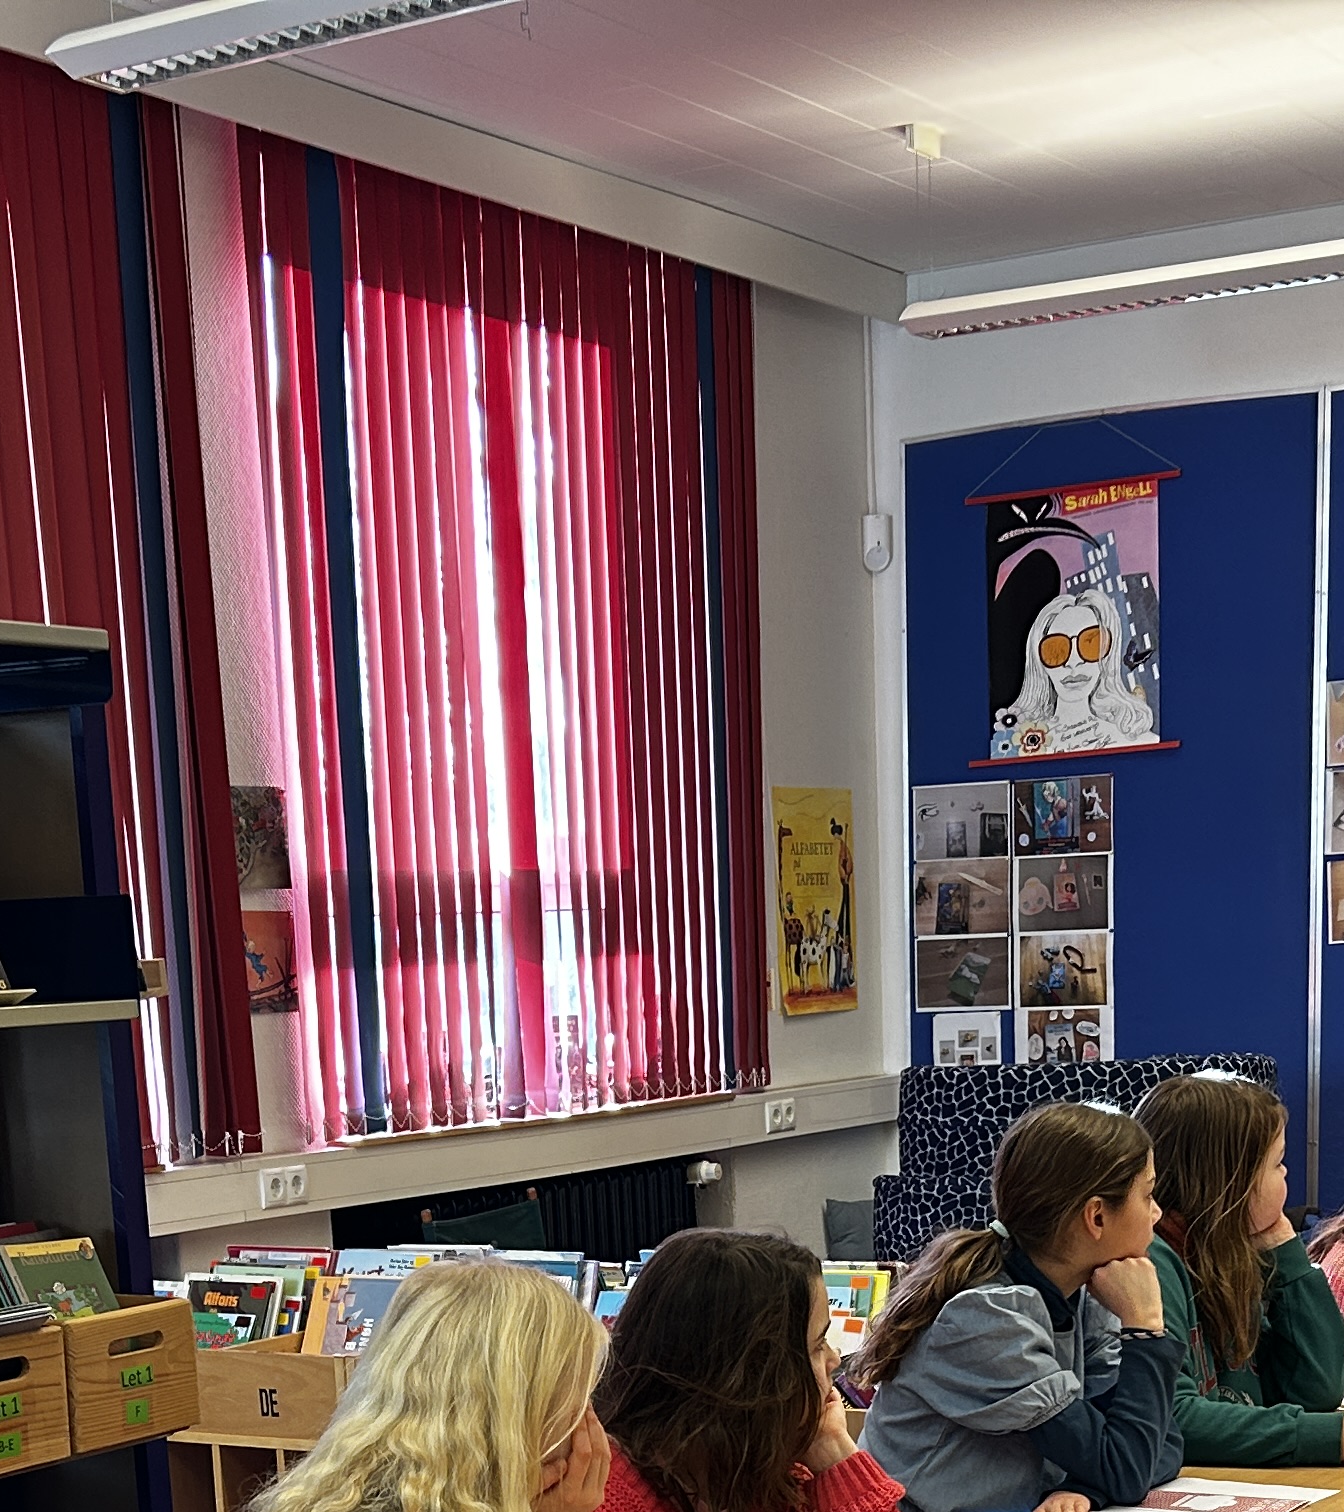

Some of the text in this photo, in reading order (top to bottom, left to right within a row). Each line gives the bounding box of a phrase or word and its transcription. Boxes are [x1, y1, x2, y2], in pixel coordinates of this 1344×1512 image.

[1064, 488, 1108, 511] Sarah
[203, 1291, 239, 1308] Alfons
[121, 1366, 154, 1388] Let 1
[11, 1396, 20, 1415] 1
[135, 1405, 141, 1417] F
[258, 1388, 280, 1418] DE
